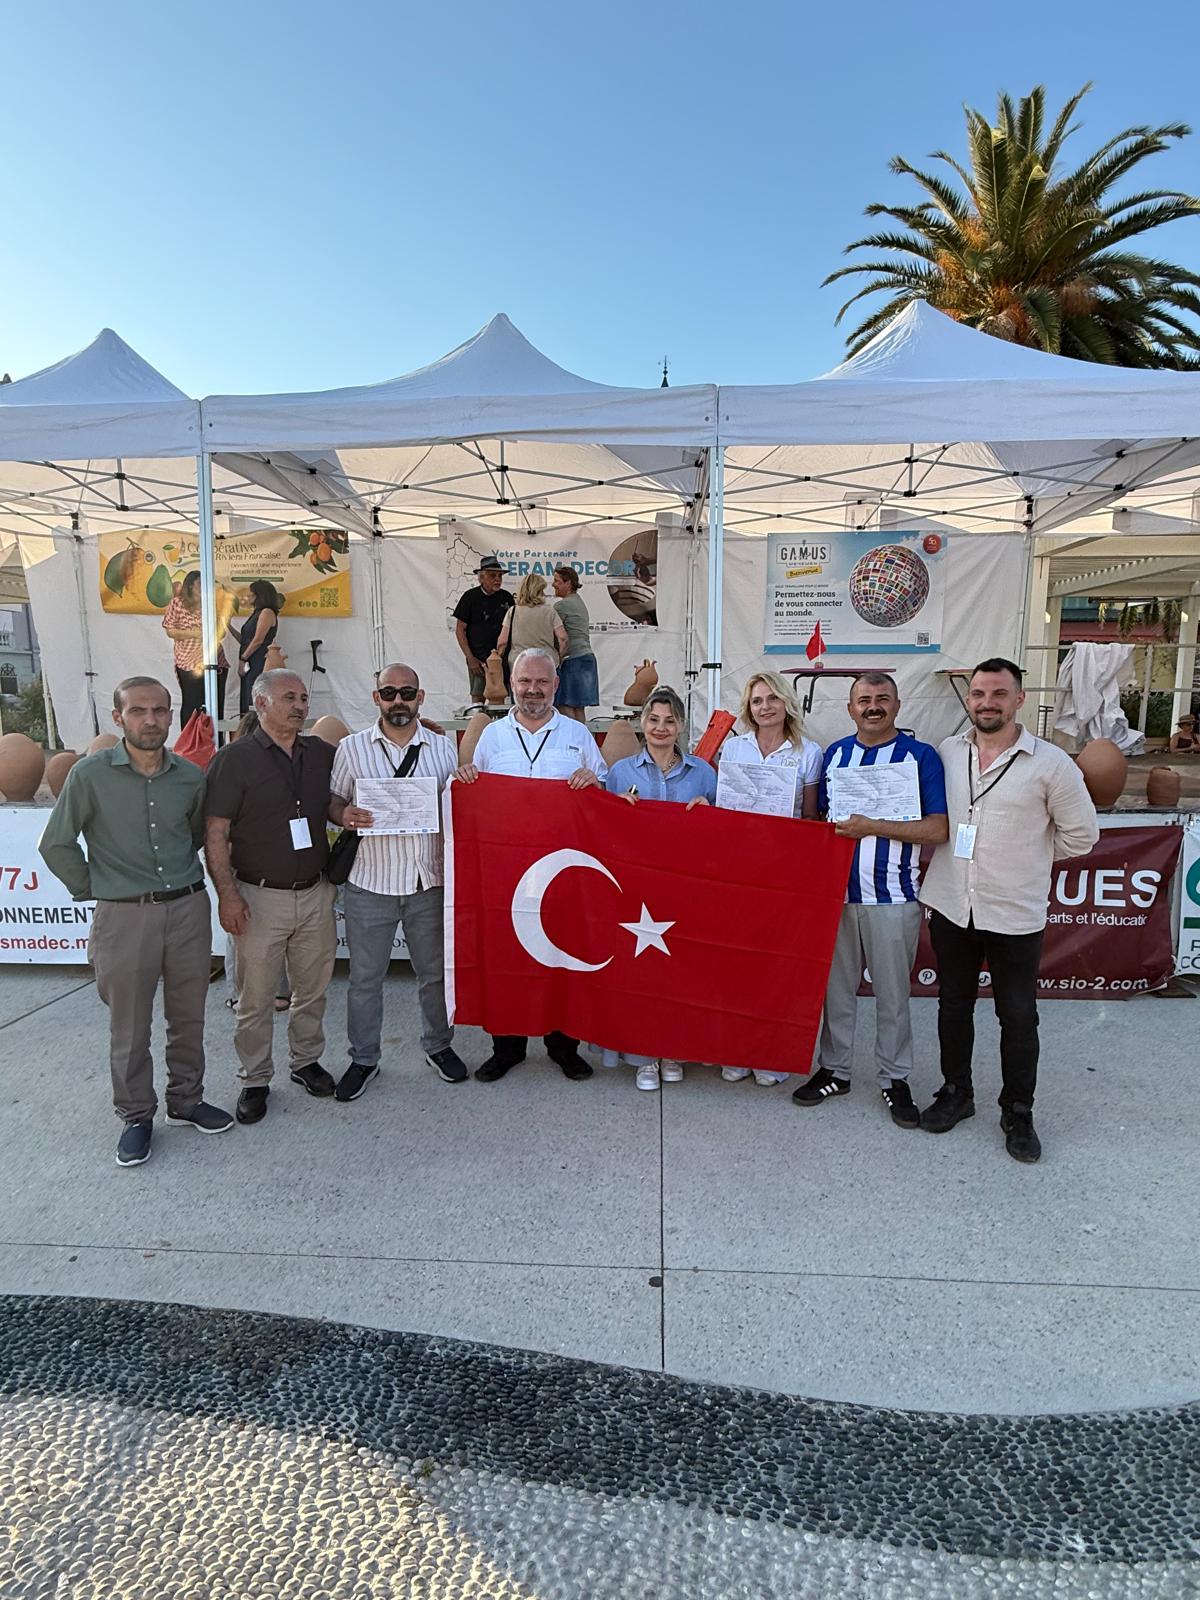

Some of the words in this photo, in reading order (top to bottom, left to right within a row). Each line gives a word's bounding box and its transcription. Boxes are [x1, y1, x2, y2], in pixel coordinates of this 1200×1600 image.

[492, 549, 520, 558] Votre
[524, 550, 578, 558] Partenaire
[774, 591, 836, 599] Permettez-nous
[1048, 869, 1162, 908] UES
[1075, 912, 1089, 925] et
[1036, 976, 1149, 991] w.sio-2.com
